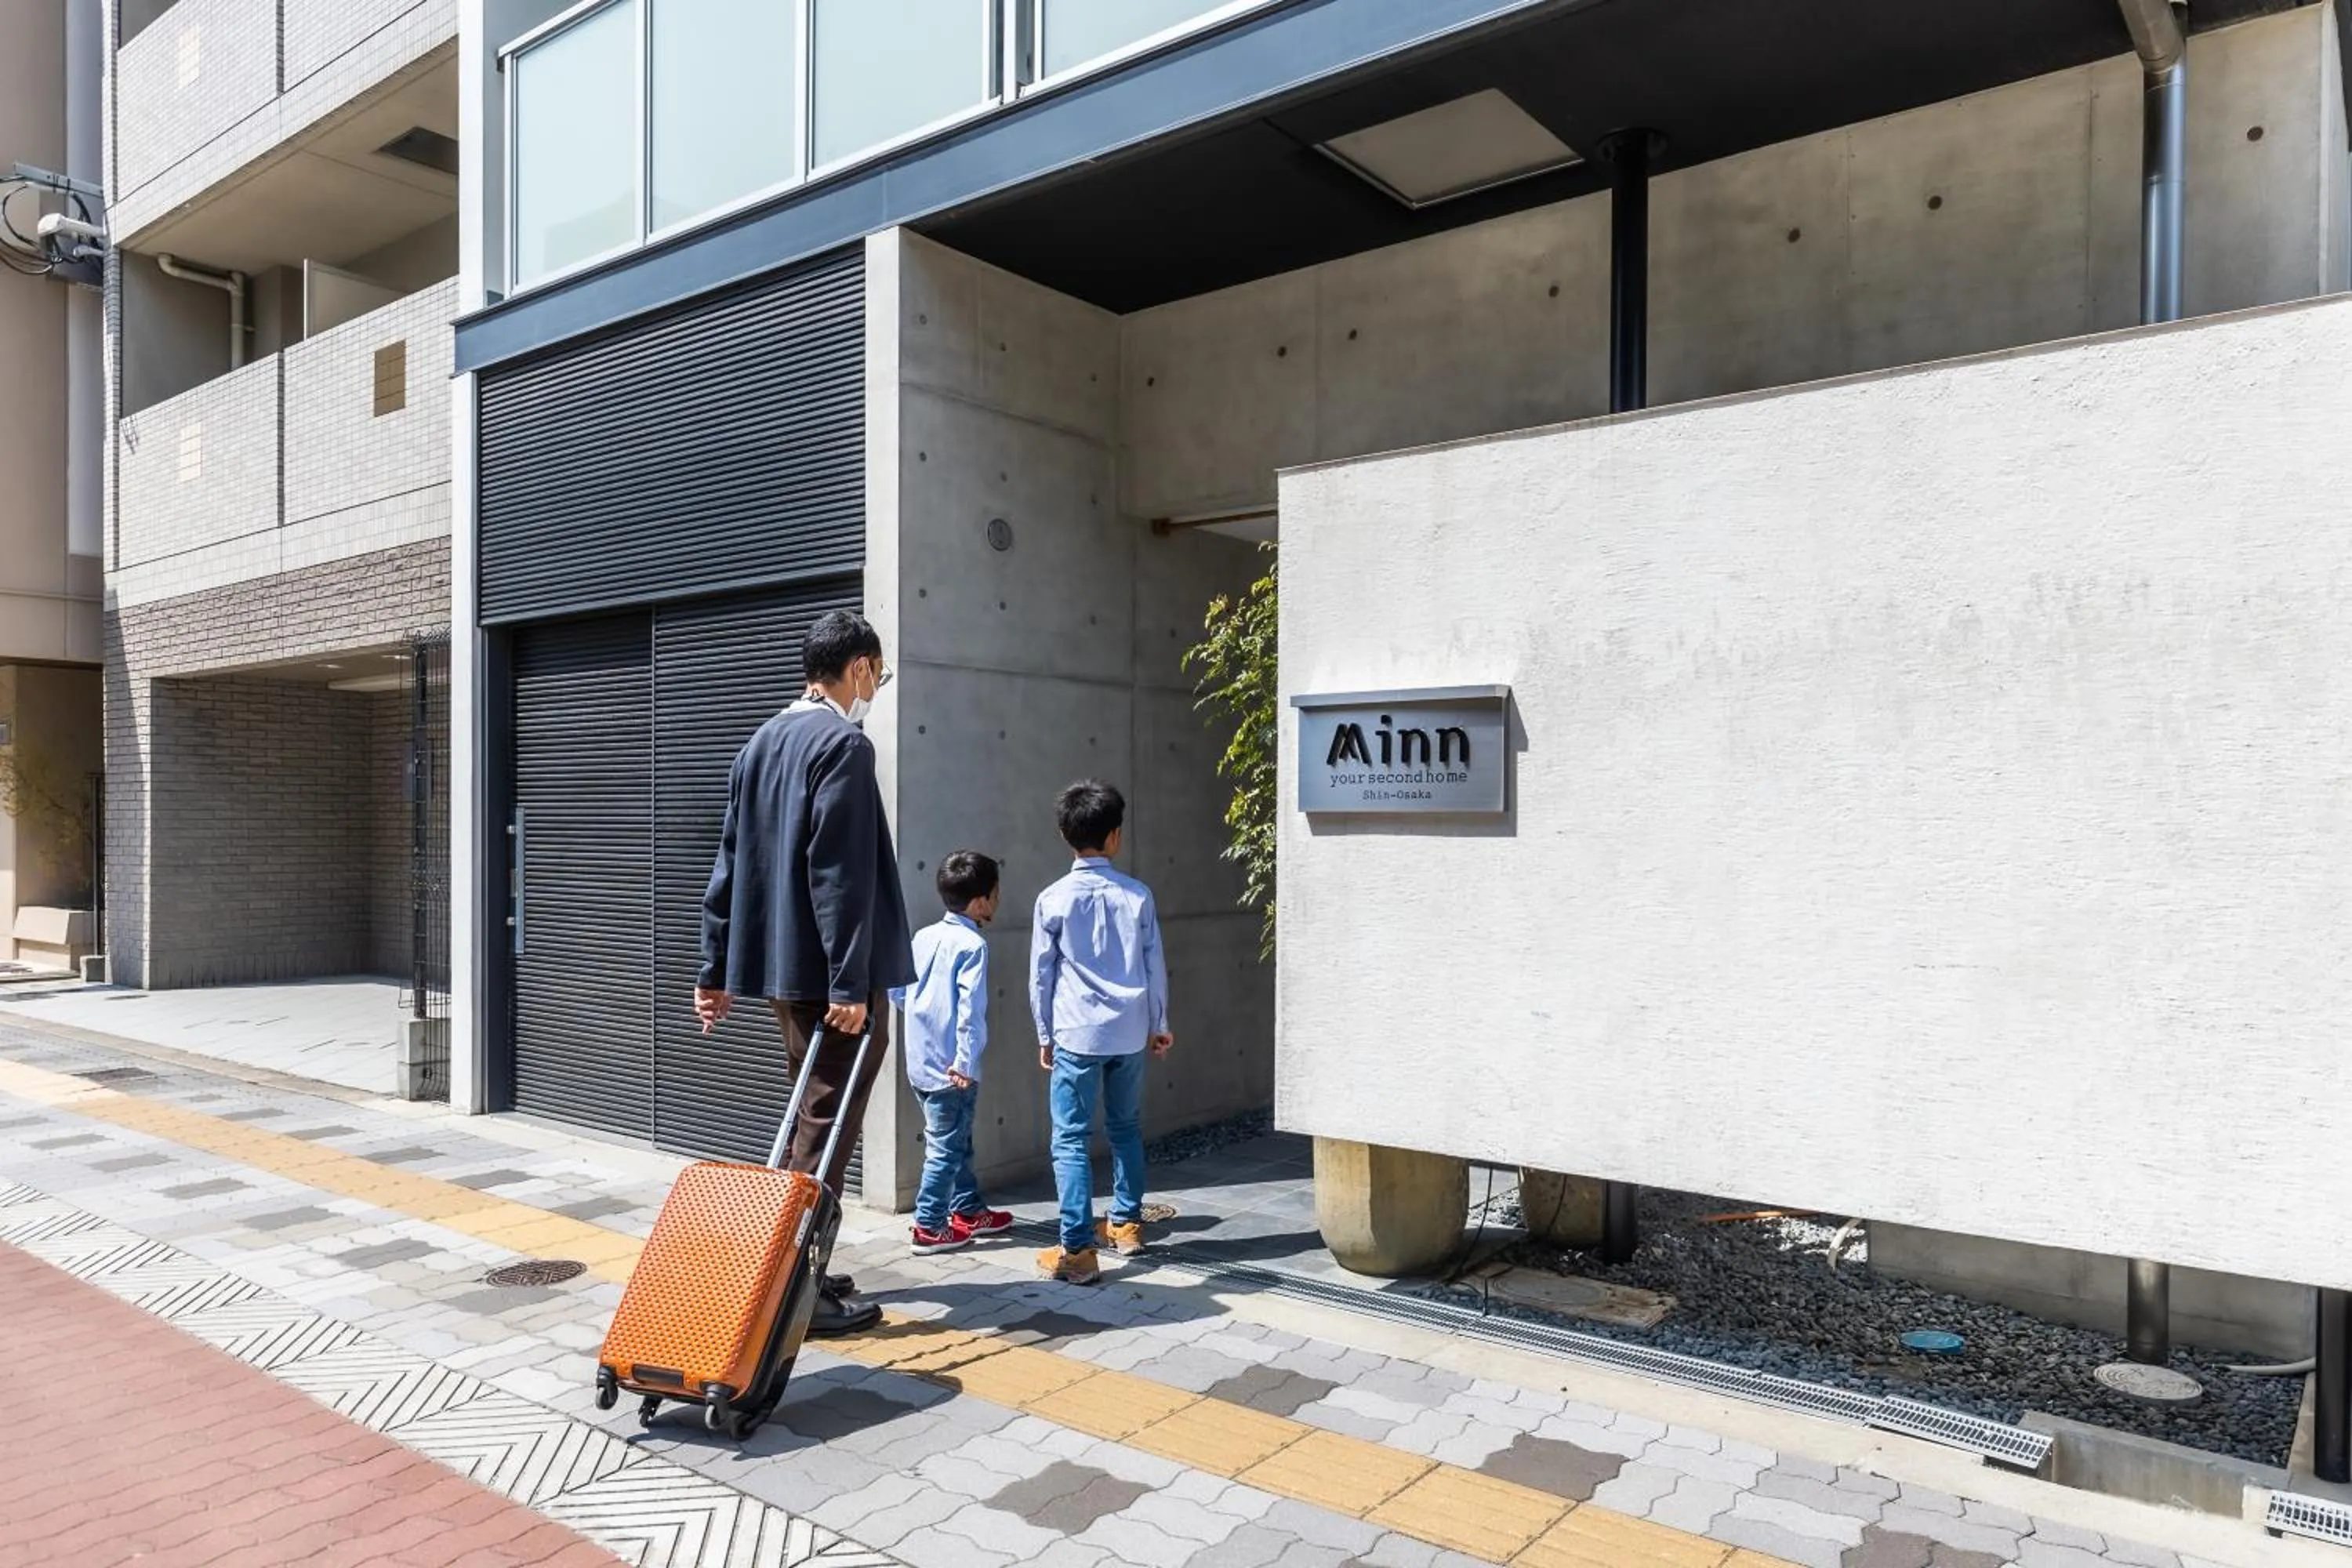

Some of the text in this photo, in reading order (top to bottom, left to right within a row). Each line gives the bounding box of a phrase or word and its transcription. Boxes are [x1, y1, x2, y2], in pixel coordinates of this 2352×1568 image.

[1327, 714, 1470, 767] Minn
[1330, 769, 1468, 787] your second home
[1363, 789, 1432, 800] Shin-Osaka
